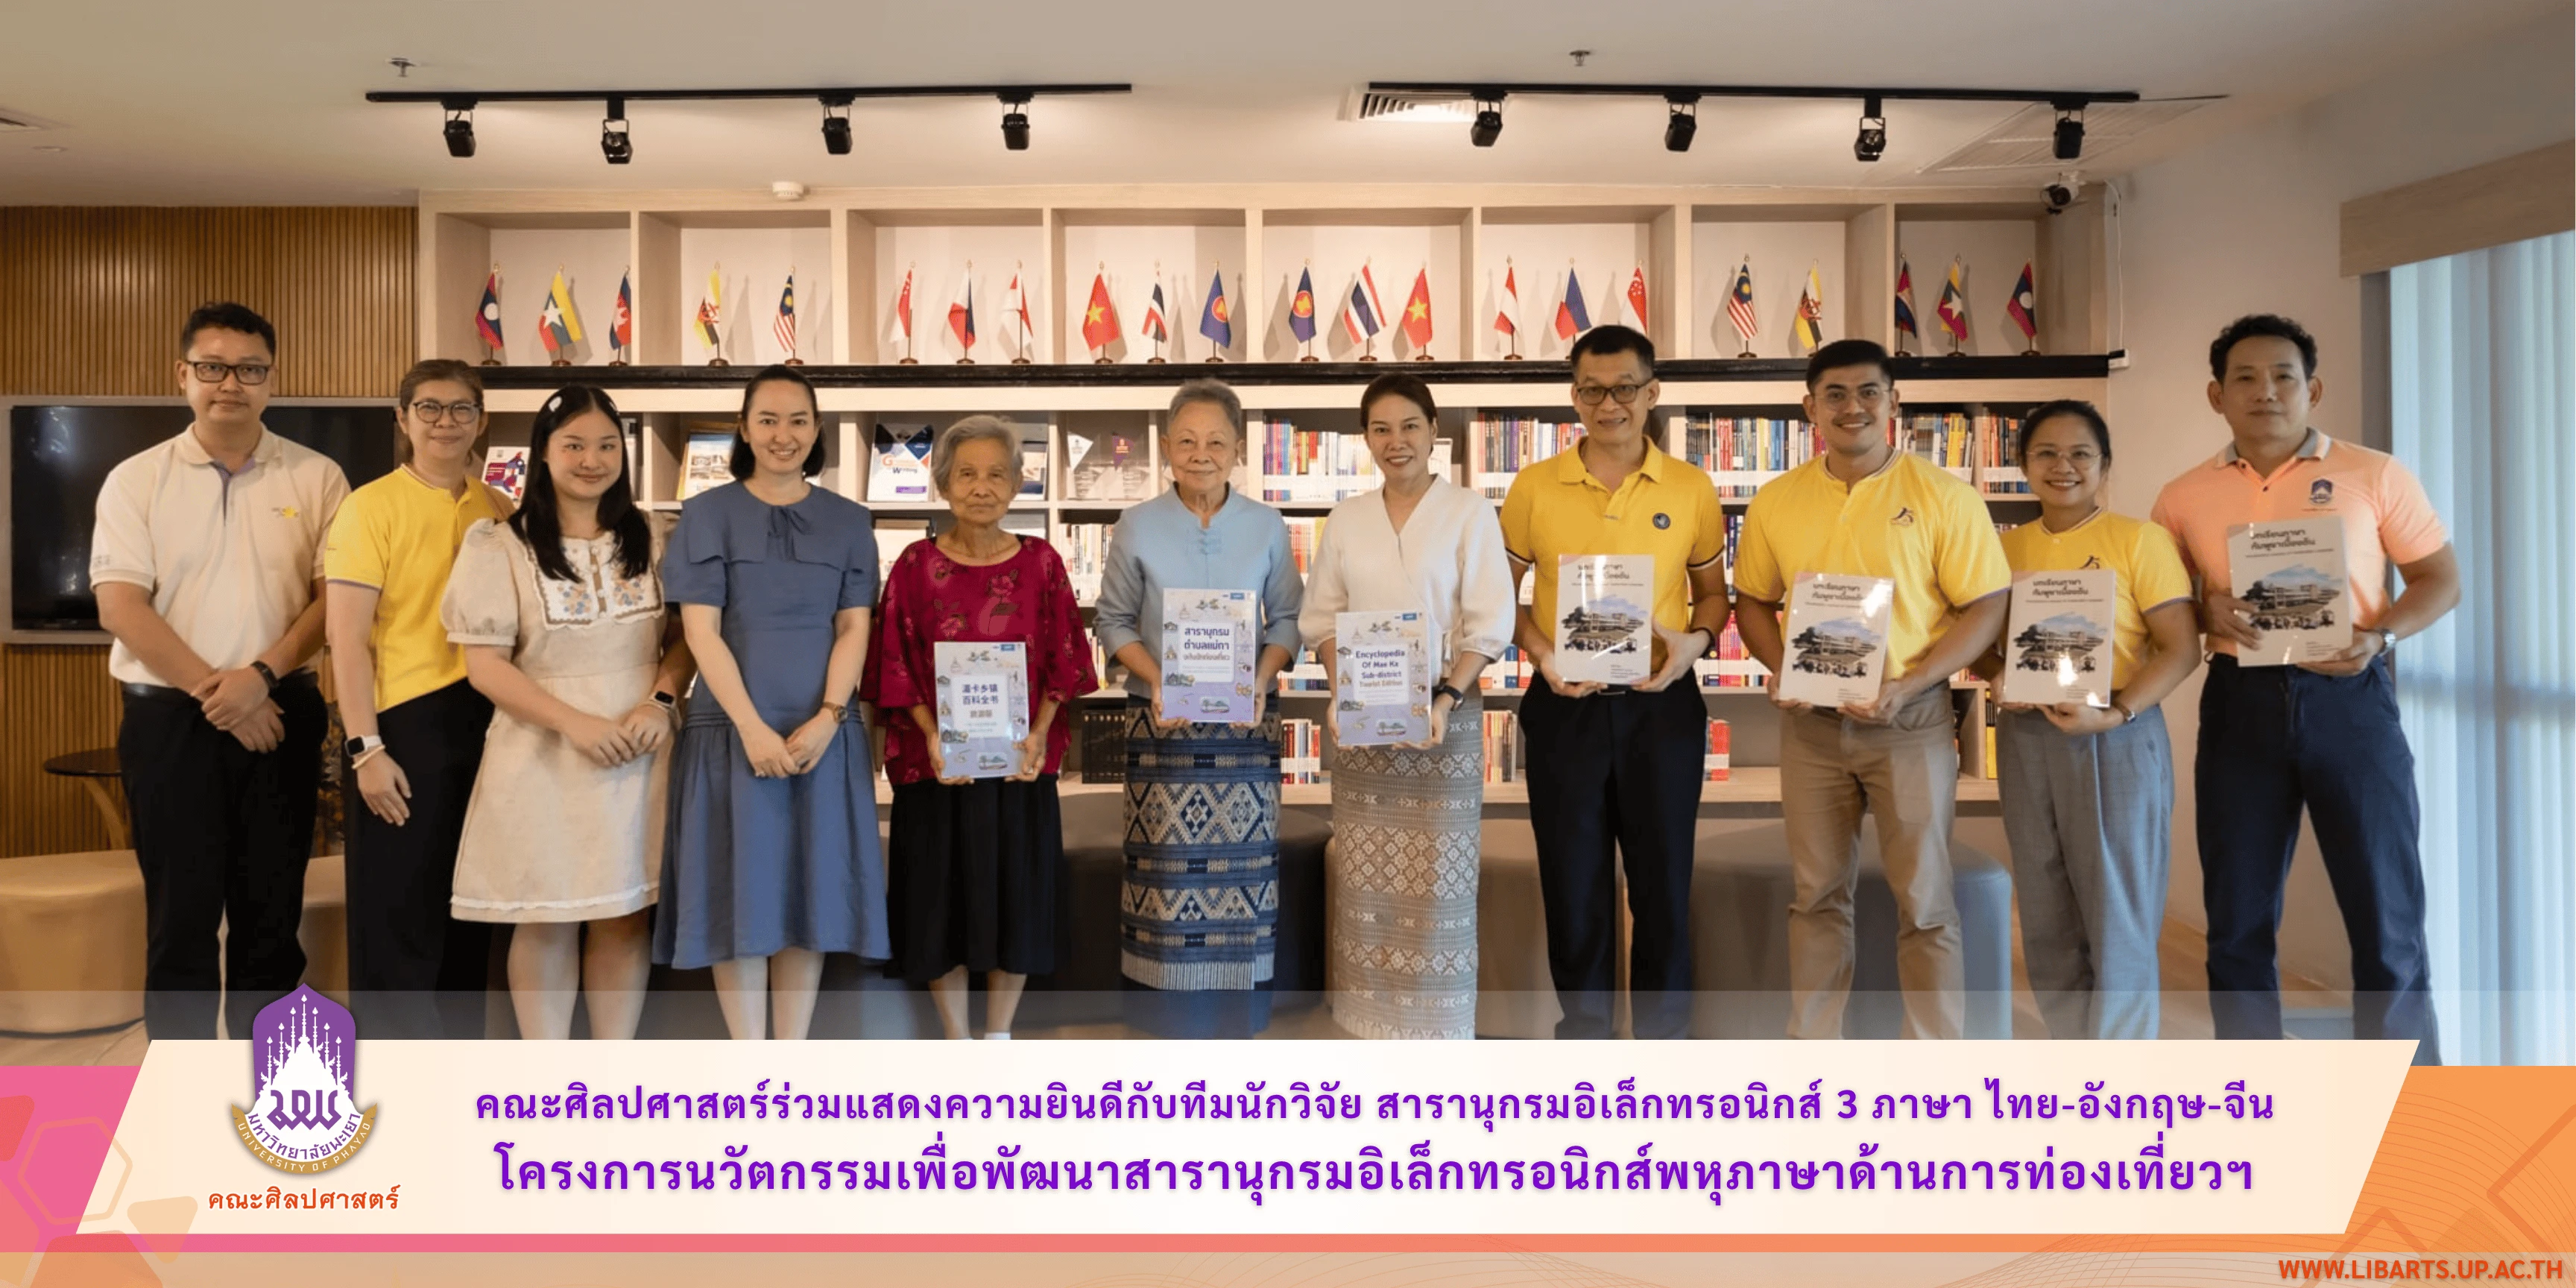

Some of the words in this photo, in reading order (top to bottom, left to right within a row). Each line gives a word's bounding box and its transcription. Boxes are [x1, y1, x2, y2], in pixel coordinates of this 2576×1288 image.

[1184, 628, 1230, 639] สารานุกรม
[1184, 639, 1230, 650] ตำบลแม่กา
[1355, 649, 1406, 660] Encyclopedia
[1361, 671, 1402, 679] Sub-district
[962, 695, 999, 705] 百科全书
